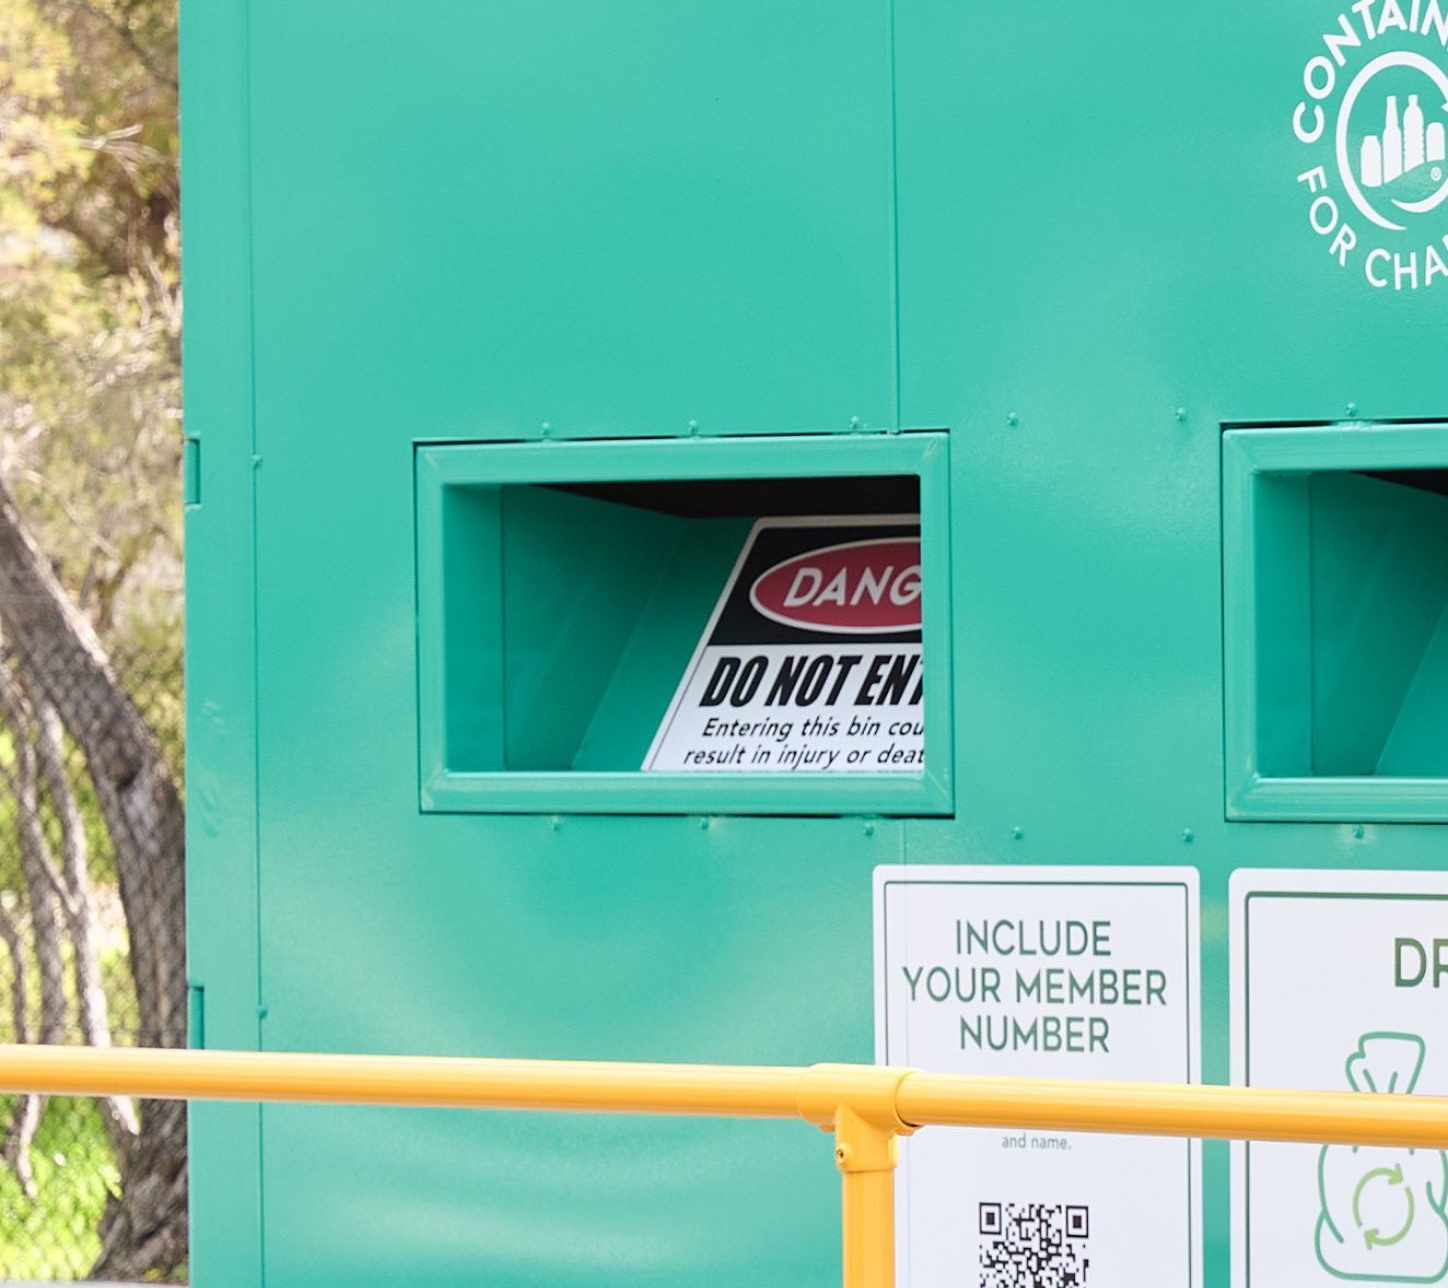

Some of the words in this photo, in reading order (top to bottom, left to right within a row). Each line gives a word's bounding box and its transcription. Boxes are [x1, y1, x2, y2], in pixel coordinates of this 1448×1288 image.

[1297, 166, 1357, 267] FOR
[700, 655, 766, 708] DO
[766, 655, 862, 708] NOT
[957, 920, 1111, 956] INCLUDE
[902, 966, 1001, 1002] YOUR
[1016, 969, 1166, 1005] MEMBER
[961, 1015, 1109, 1053] NUMBER
